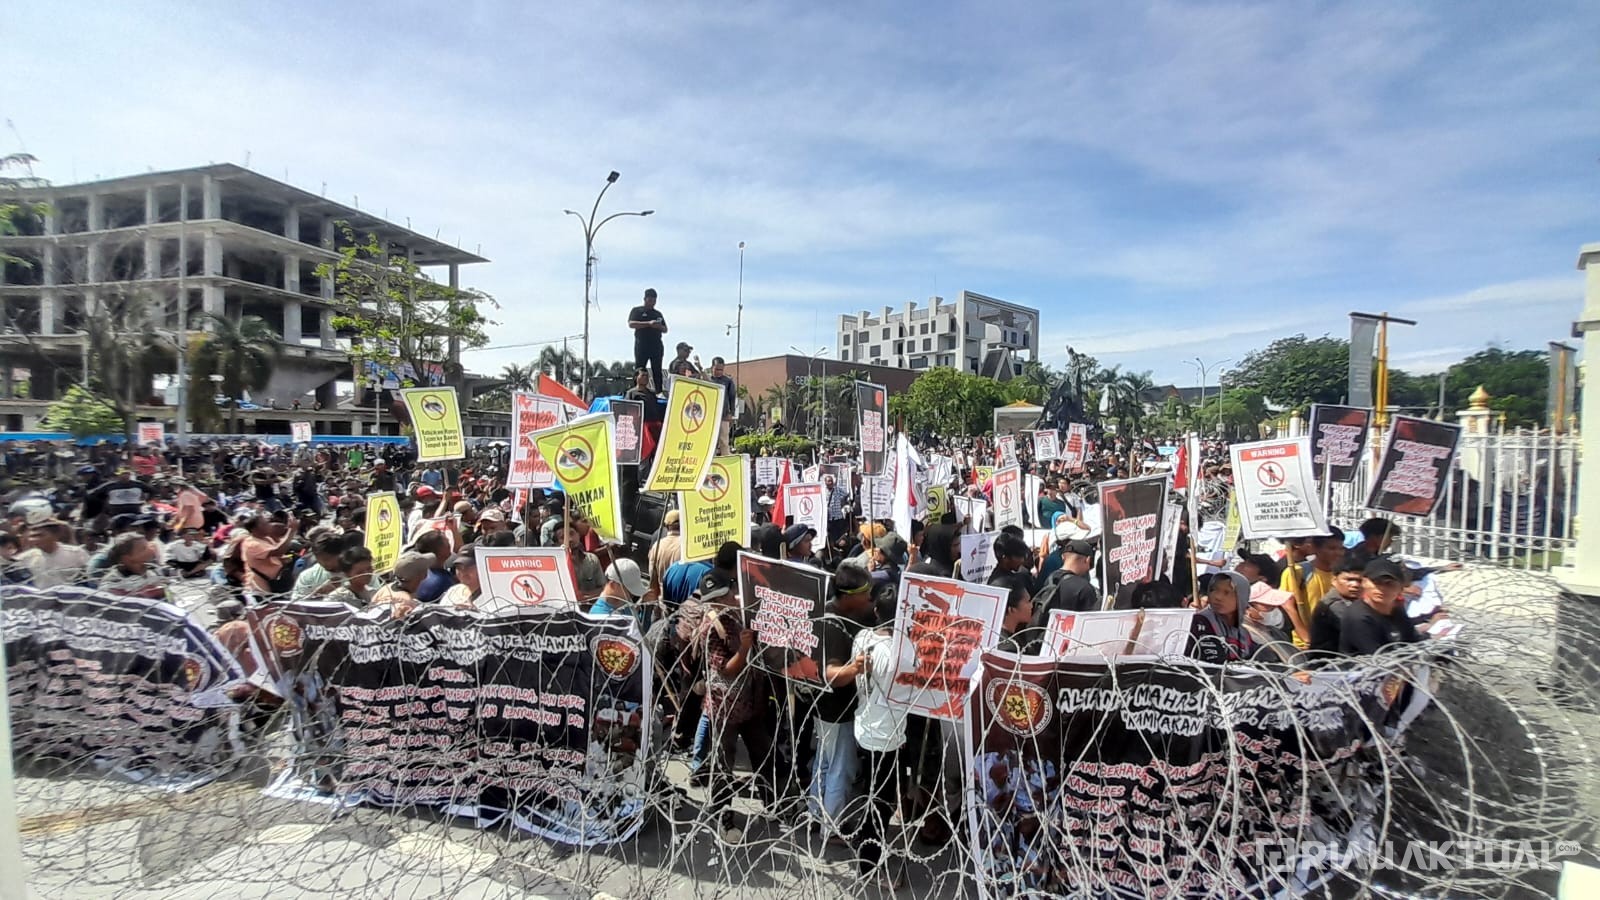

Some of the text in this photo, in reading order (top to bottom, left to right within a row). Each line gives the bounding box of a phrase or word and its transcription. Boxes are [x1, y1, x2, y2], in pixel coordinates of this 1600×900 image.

[1250, 447, 1286, 458] WARNING
[698, 503, 732, 516] Pemerintah
[1255, 501, 1279, 509] JANGAN
[711, 509, 736, 520] Lindungi
[693, 533, 710, 544] LUPA
[501, 558, 543, 569] WARNING
[755, 586, 814, 611] PEMERINTAH
[761, 600, 807, 619] LINDUNGI
[789, 619, 813, 632] TAPI
[1056, 686, 1131, 713] ALIAN
[1160, 714, 1204, 737] AKAN
[1065, 774, 1127, 798] KAPOLRES
